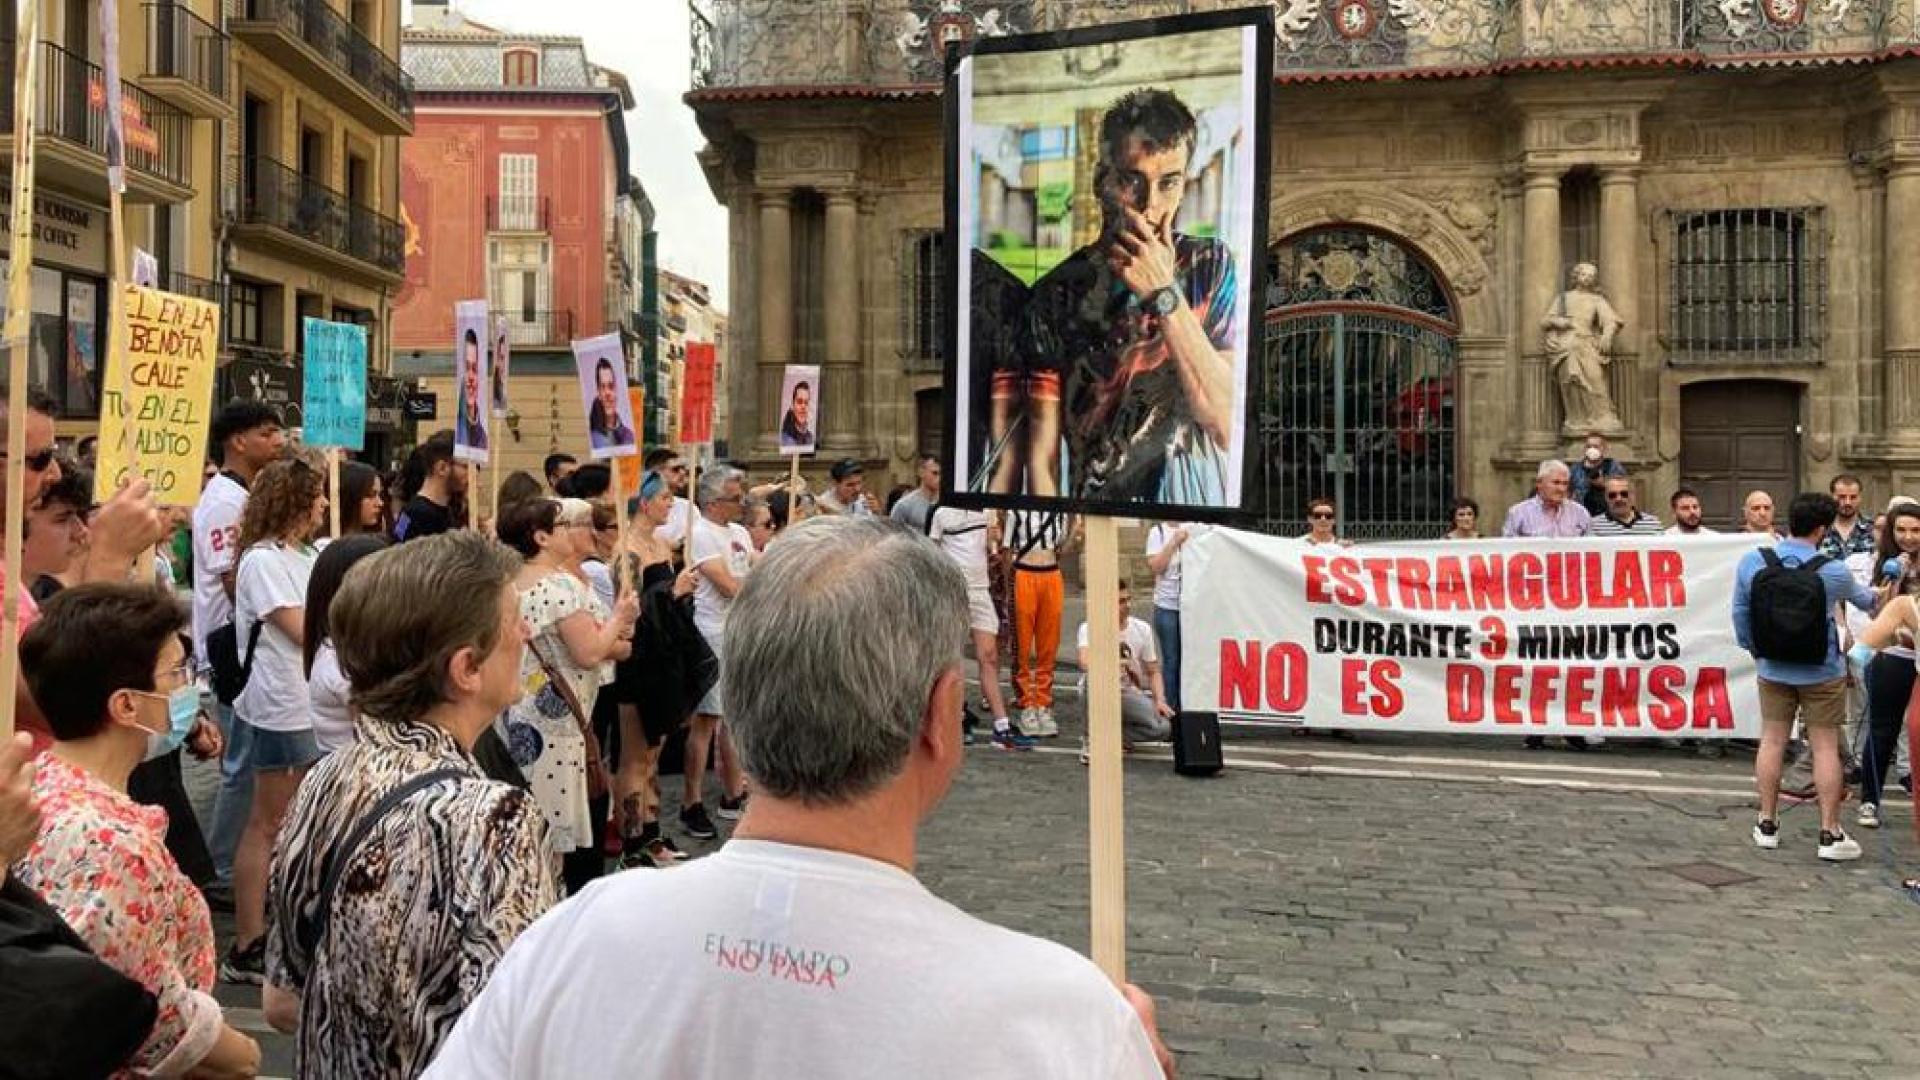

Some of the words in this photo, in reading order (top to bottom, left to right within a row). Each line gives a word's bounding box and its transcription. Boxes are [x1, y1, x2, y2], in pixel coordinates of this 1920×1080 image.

[158, 298, 186, 325] EN
[192, 304, 215, 335] LA
[130, 360, 190, 389] CALLE
[137, 394, 165, 420] EN
[169, 398, 200, 424] EL
[117, 427, 191, 456] ALDITO
[1302, 549, 1687, 611] ESTRANGULAR
[1314, 618, 1472, 660] DURANTE
[1479, 615, 1508, 660] 3
[1517, 622, 1681, 660] MINUTOS
[1219, 639, 1308, 713] NO
[1341, 659, 1404, 717] ES
[1446, 663, 1734, 731] DEFENSA
[717, 946, 760, 973] NO
[771, 950, 835, 990] PASA
[740, 938, 850, 977] TIEMPO
